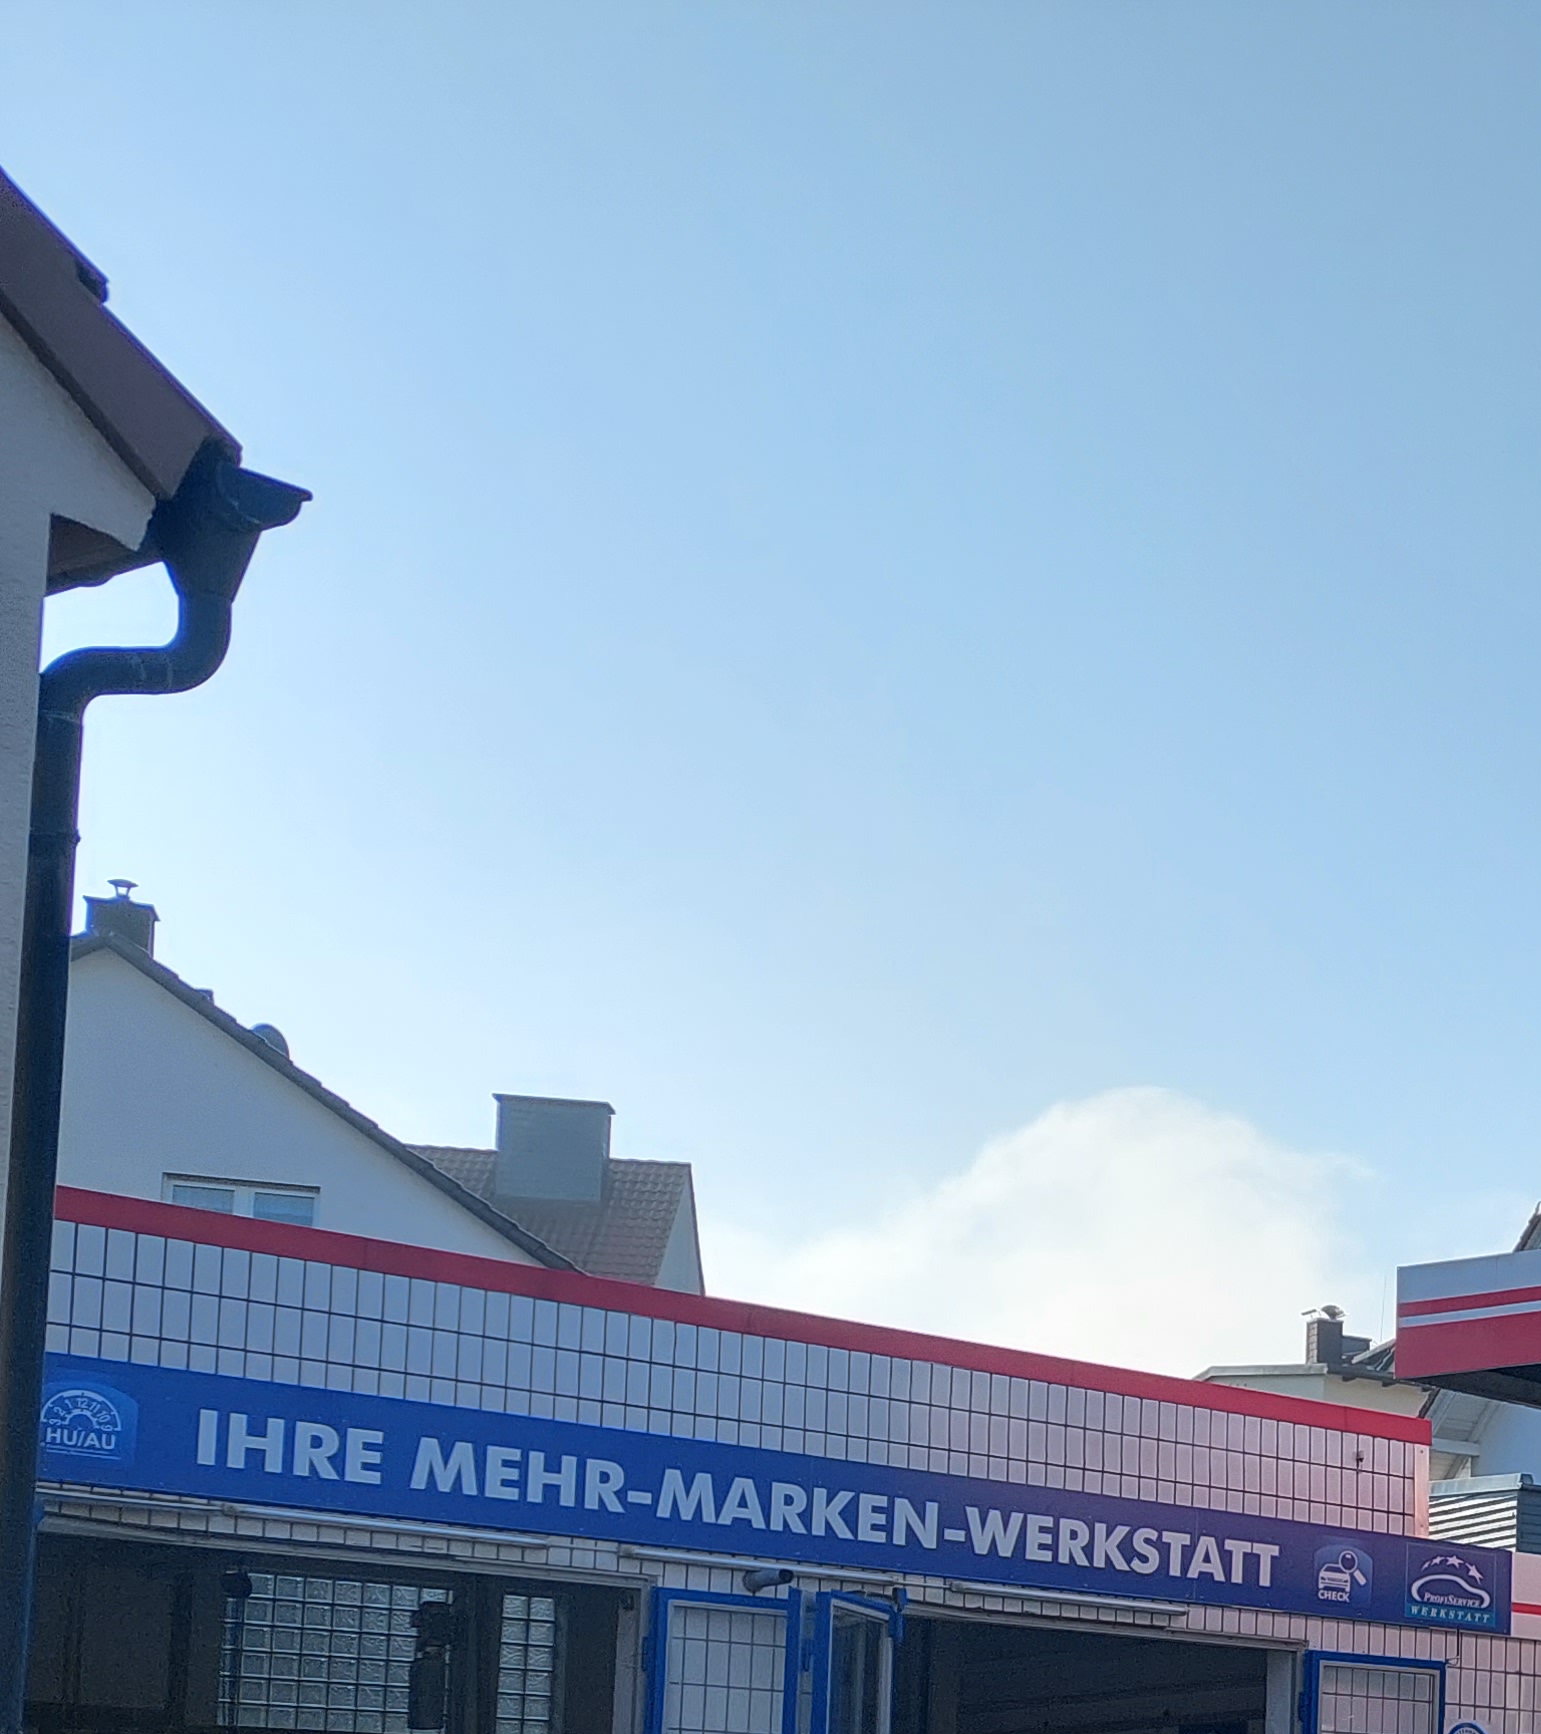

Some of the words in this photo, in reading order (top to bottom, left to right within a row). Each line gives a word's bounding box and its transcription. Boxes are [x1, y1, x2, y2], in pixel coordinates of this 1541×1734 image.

[46, 1427, 116, 1450] HU/AU
[197, 1409, 384, 1485] IHRE
[410, 1436, 1280, 1588] MEHR-MARKEN-WERKSTATT
[1318, 1589, 1350, 1602] CHECK
[1411, 1605, 1490, 1623] WERKSTATT
